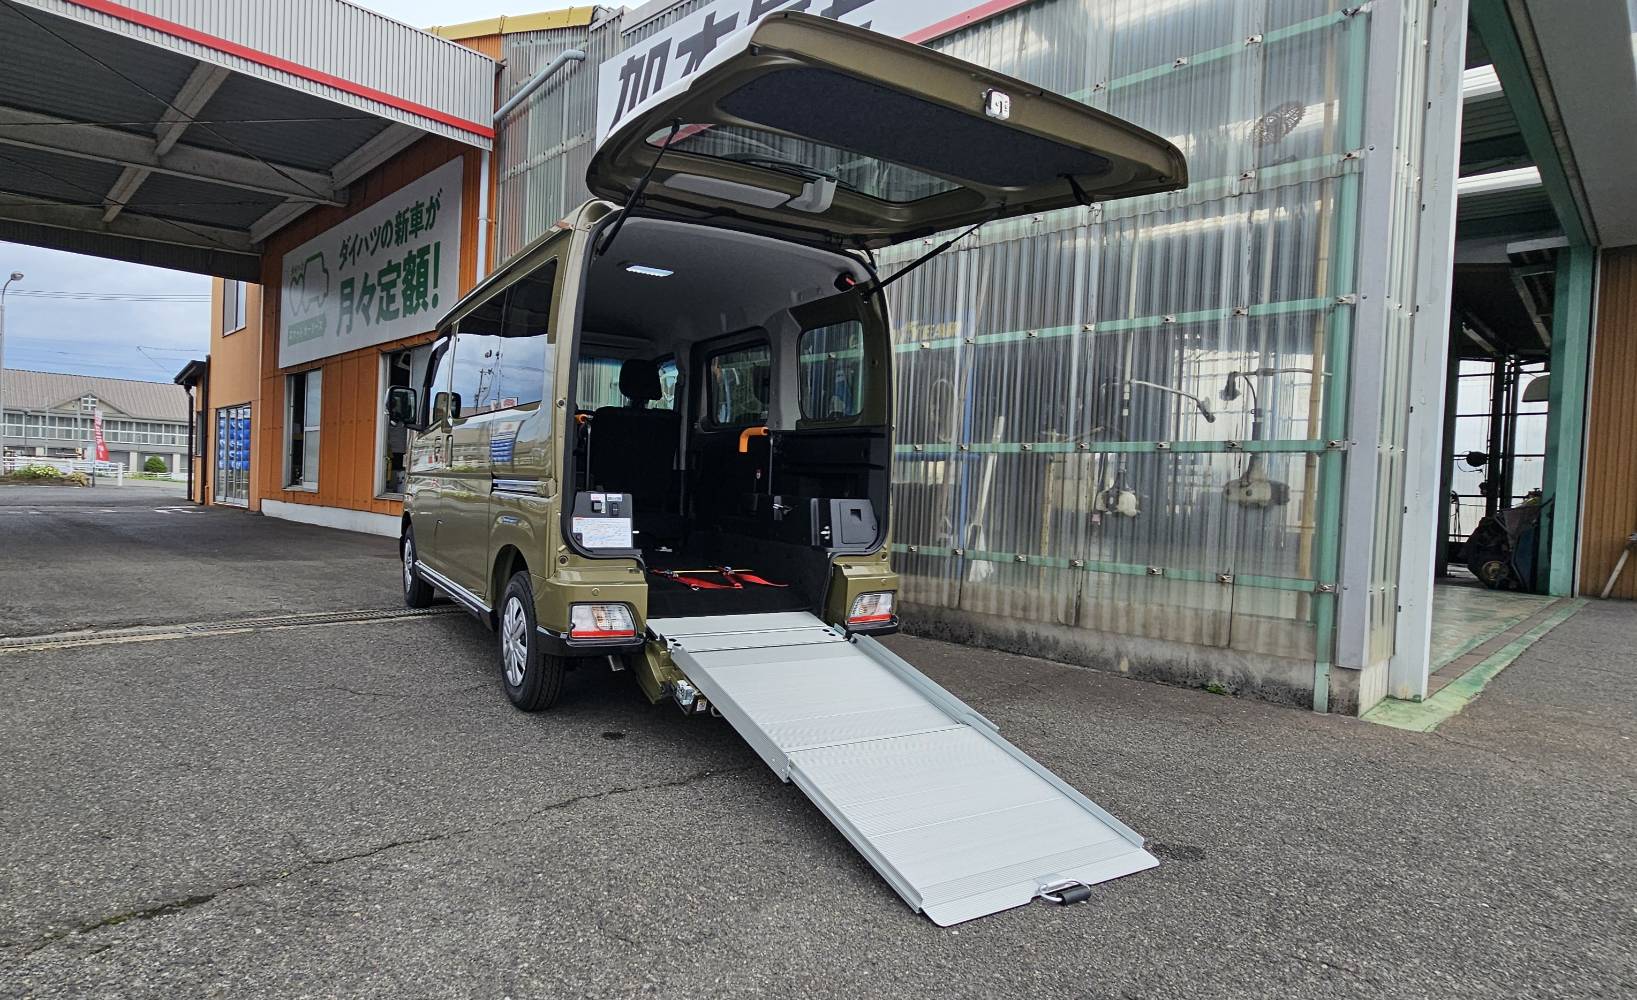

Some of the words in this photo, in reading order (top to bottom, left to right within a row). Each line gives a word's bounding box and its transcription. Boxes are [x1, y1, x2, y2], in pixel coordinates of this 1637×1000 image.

[339, 187, 443, 271] ダイハツの新車が
[336, 240, 441, 337] 月々定額!
